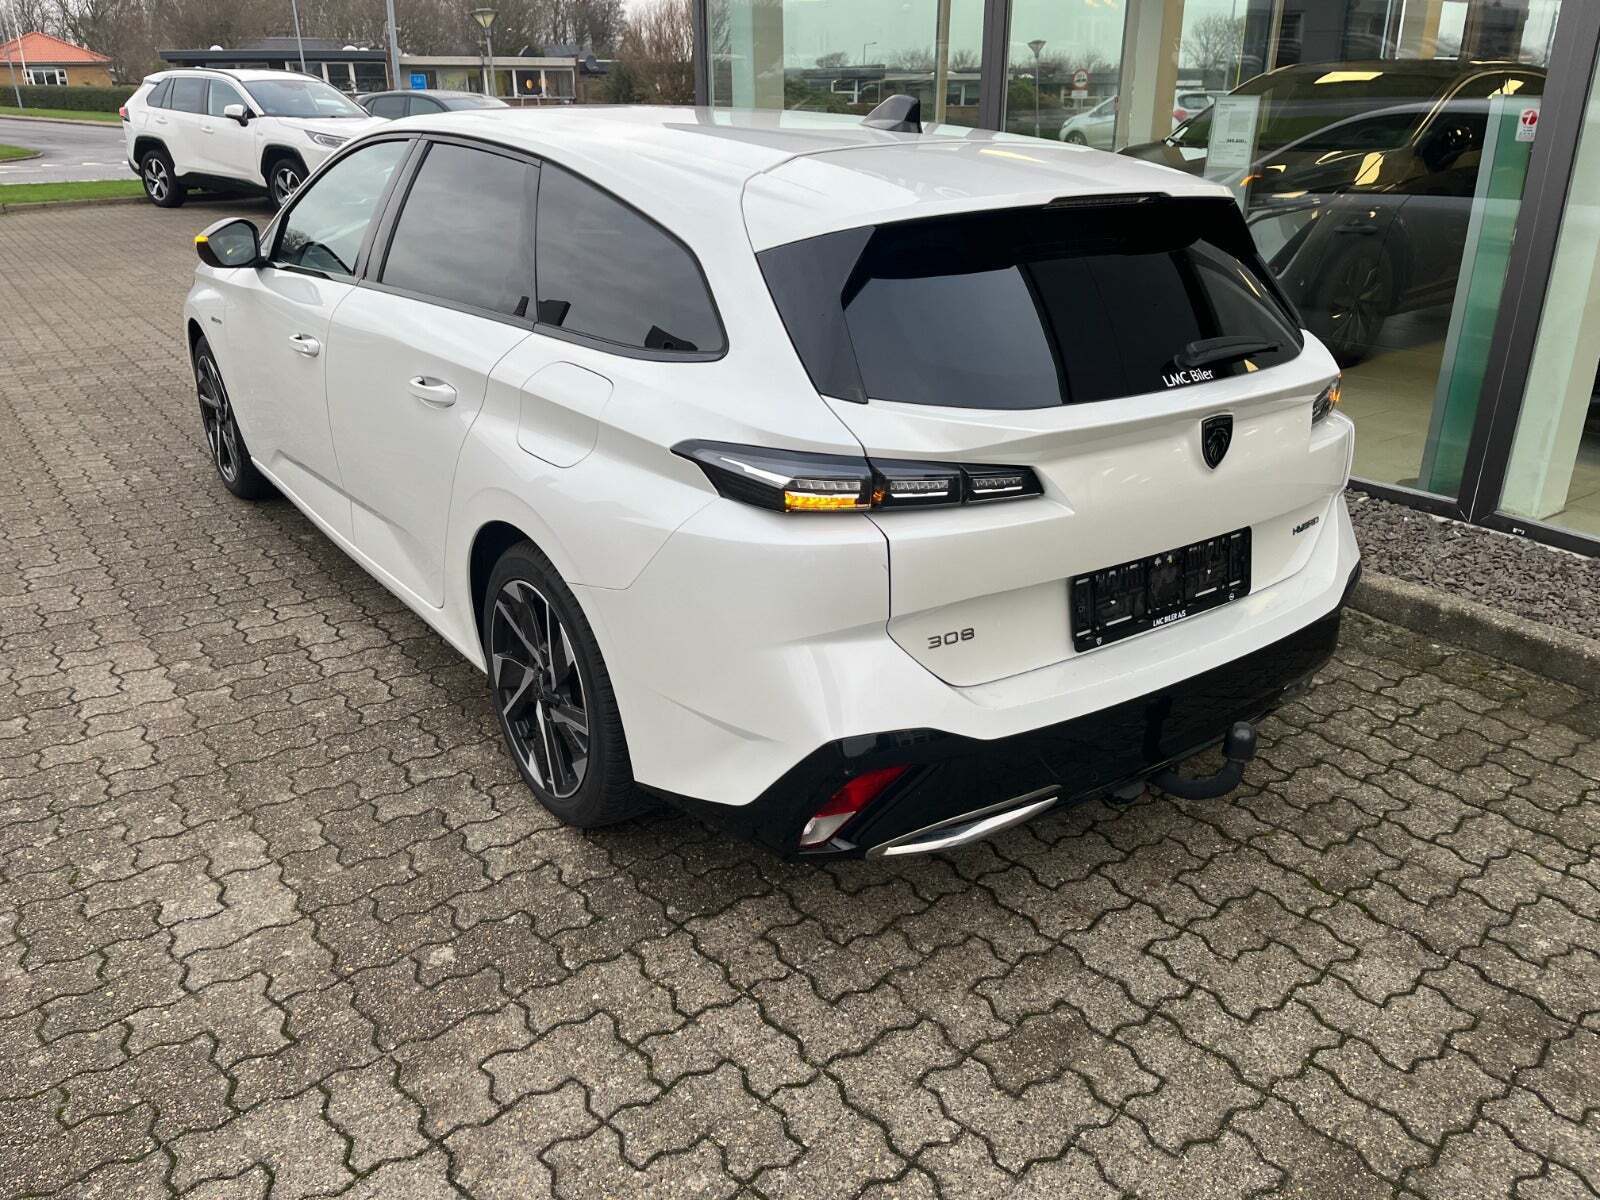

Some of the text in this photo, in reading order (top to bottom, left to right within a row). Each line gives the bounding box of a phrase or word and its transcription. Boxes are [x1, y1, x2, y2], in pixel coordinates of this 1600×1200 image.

[1162, 368, 1214, 387] LMC Biler
[927, 627, 975, 649] 308
